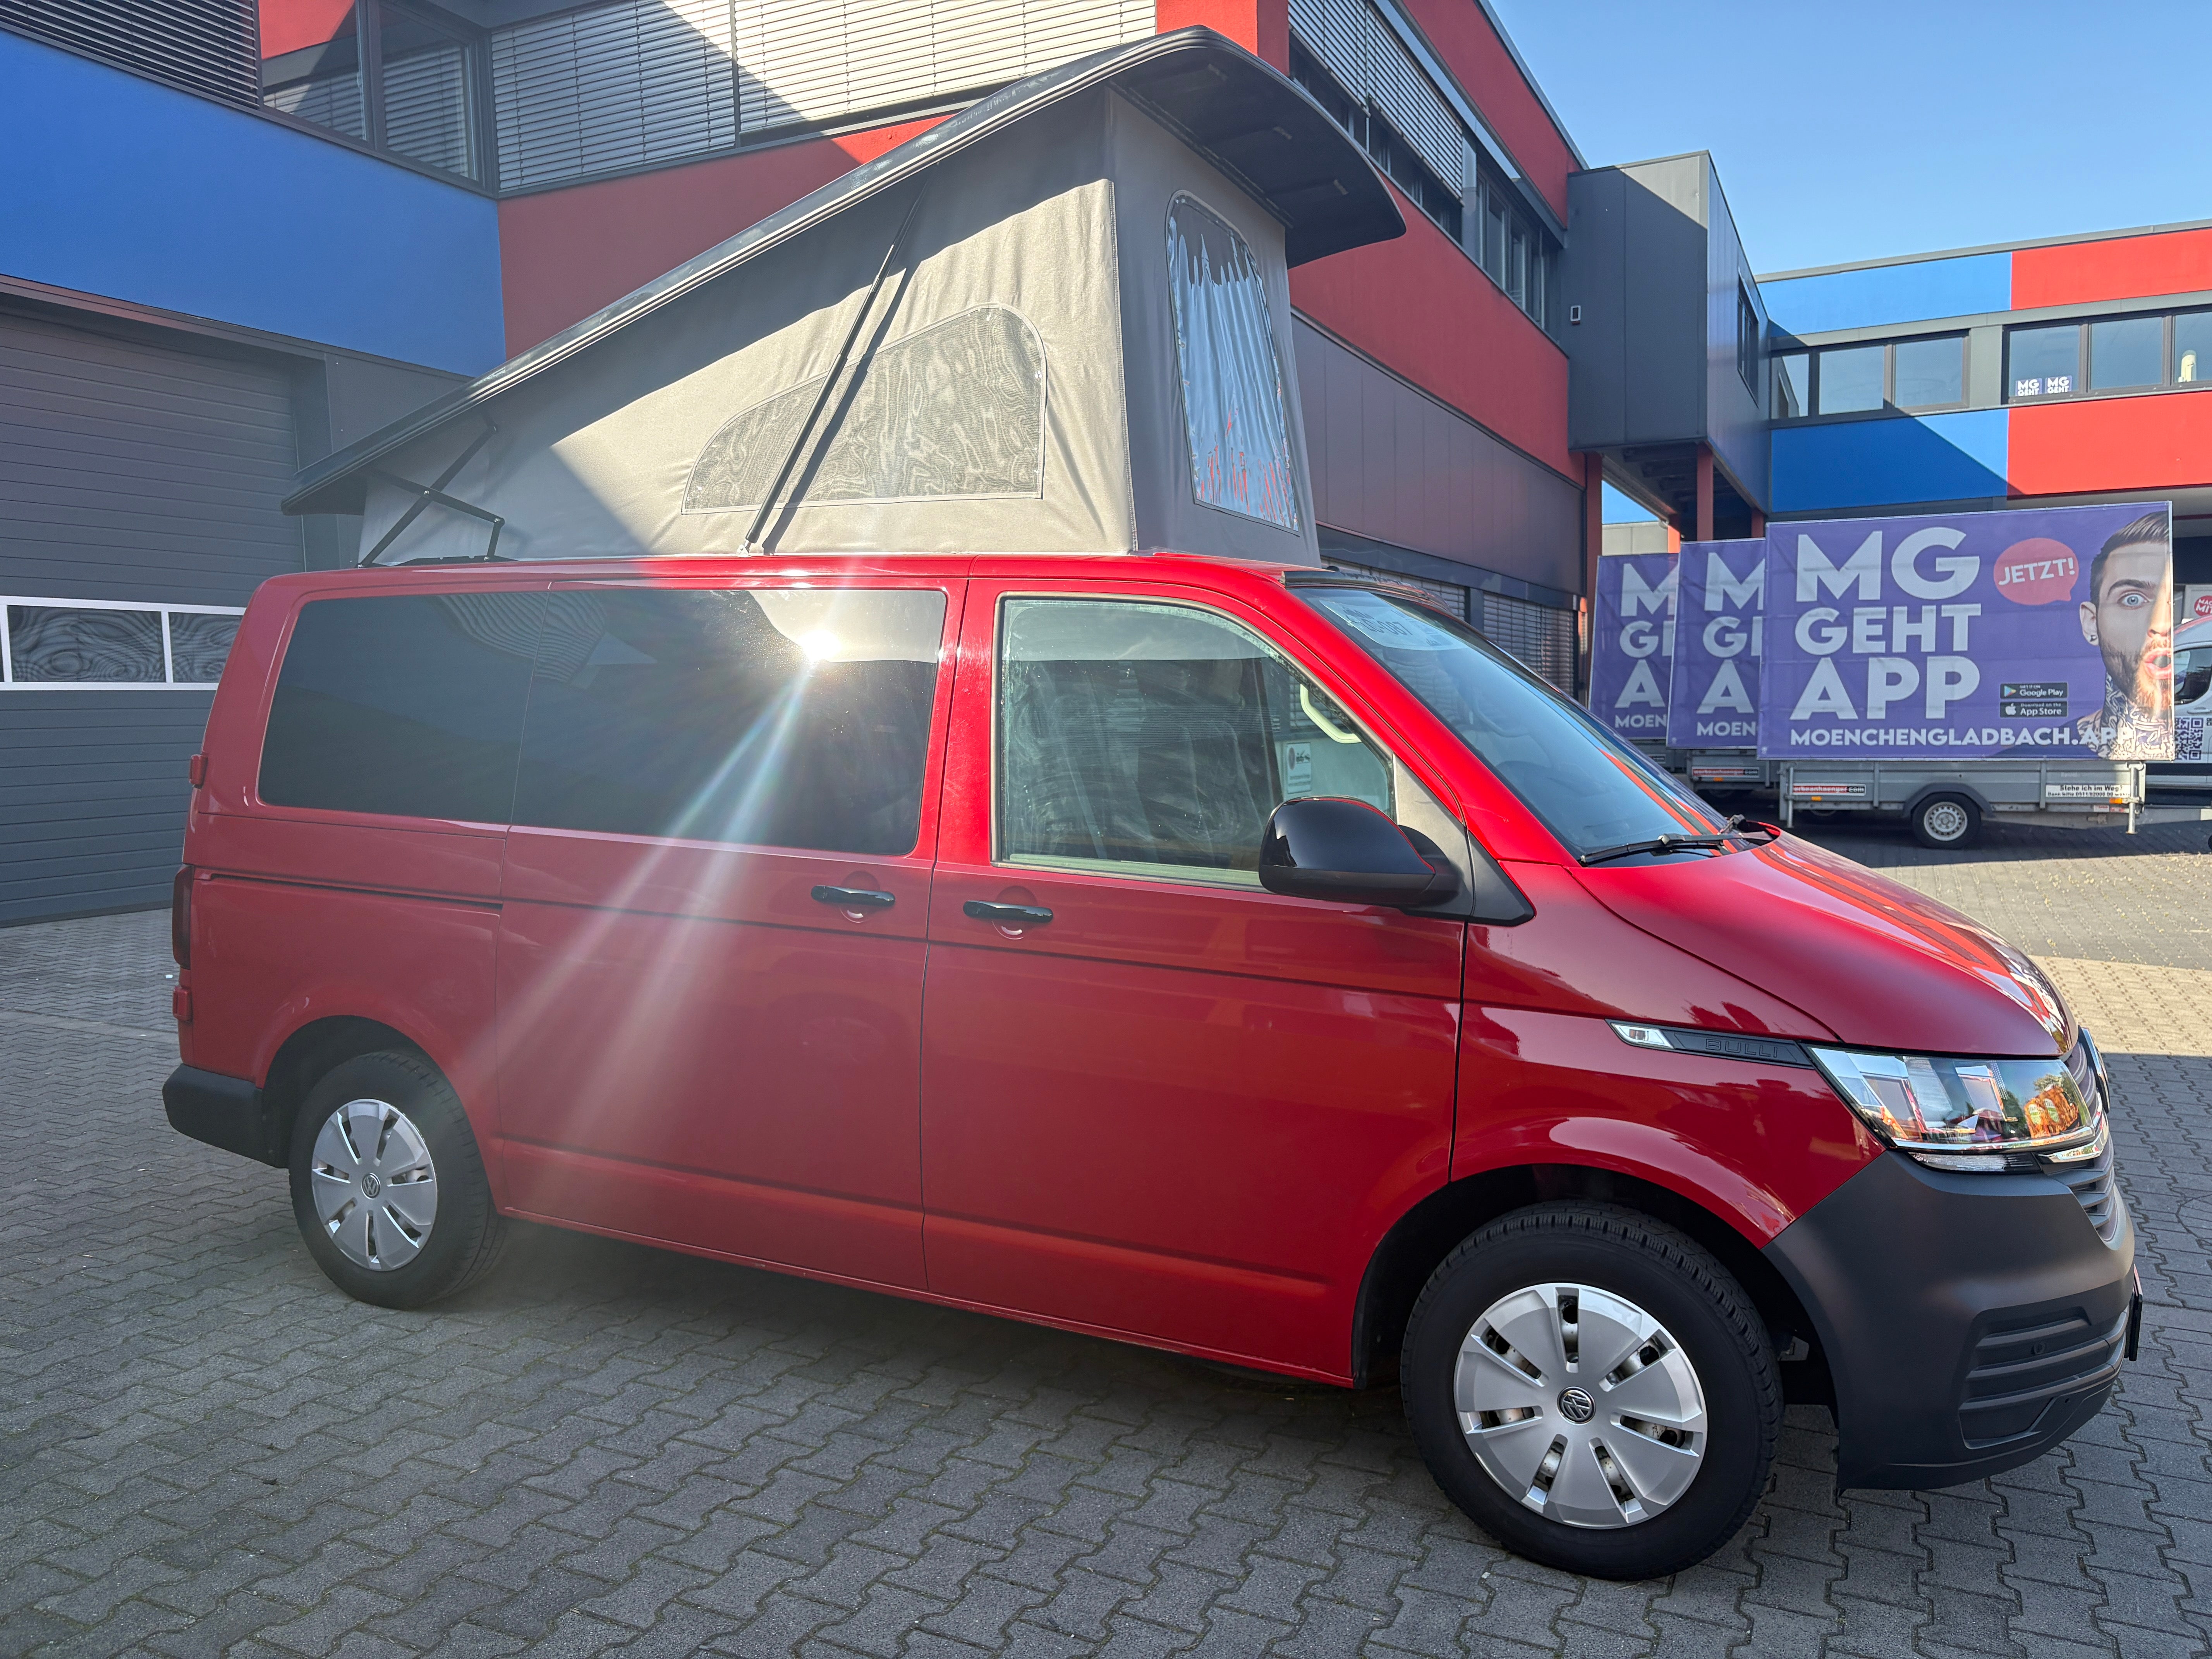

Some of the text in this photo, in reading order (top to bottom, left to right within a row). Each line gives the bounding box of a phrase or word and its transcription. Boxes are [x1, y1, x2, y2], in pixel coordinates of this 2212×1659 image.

[2018, 379, 2039, 390] MG
[2047, 376, 2069, 387] MG
[1796, 527, 1980, 602] MG
[1998, 557, 2075, 586] JETZT!
[1795, 603, 1981, 655] GEHT
[1789, 656, 1980, 720] APP
[2020, 688, 2064, 697] Google Play
[2020, 707, 2062, 716] App Store
[1790, 727, 2133, 746] MOENCHENGLADBACH.APP
[1705, 1039, 1778, 1058] BULLI
